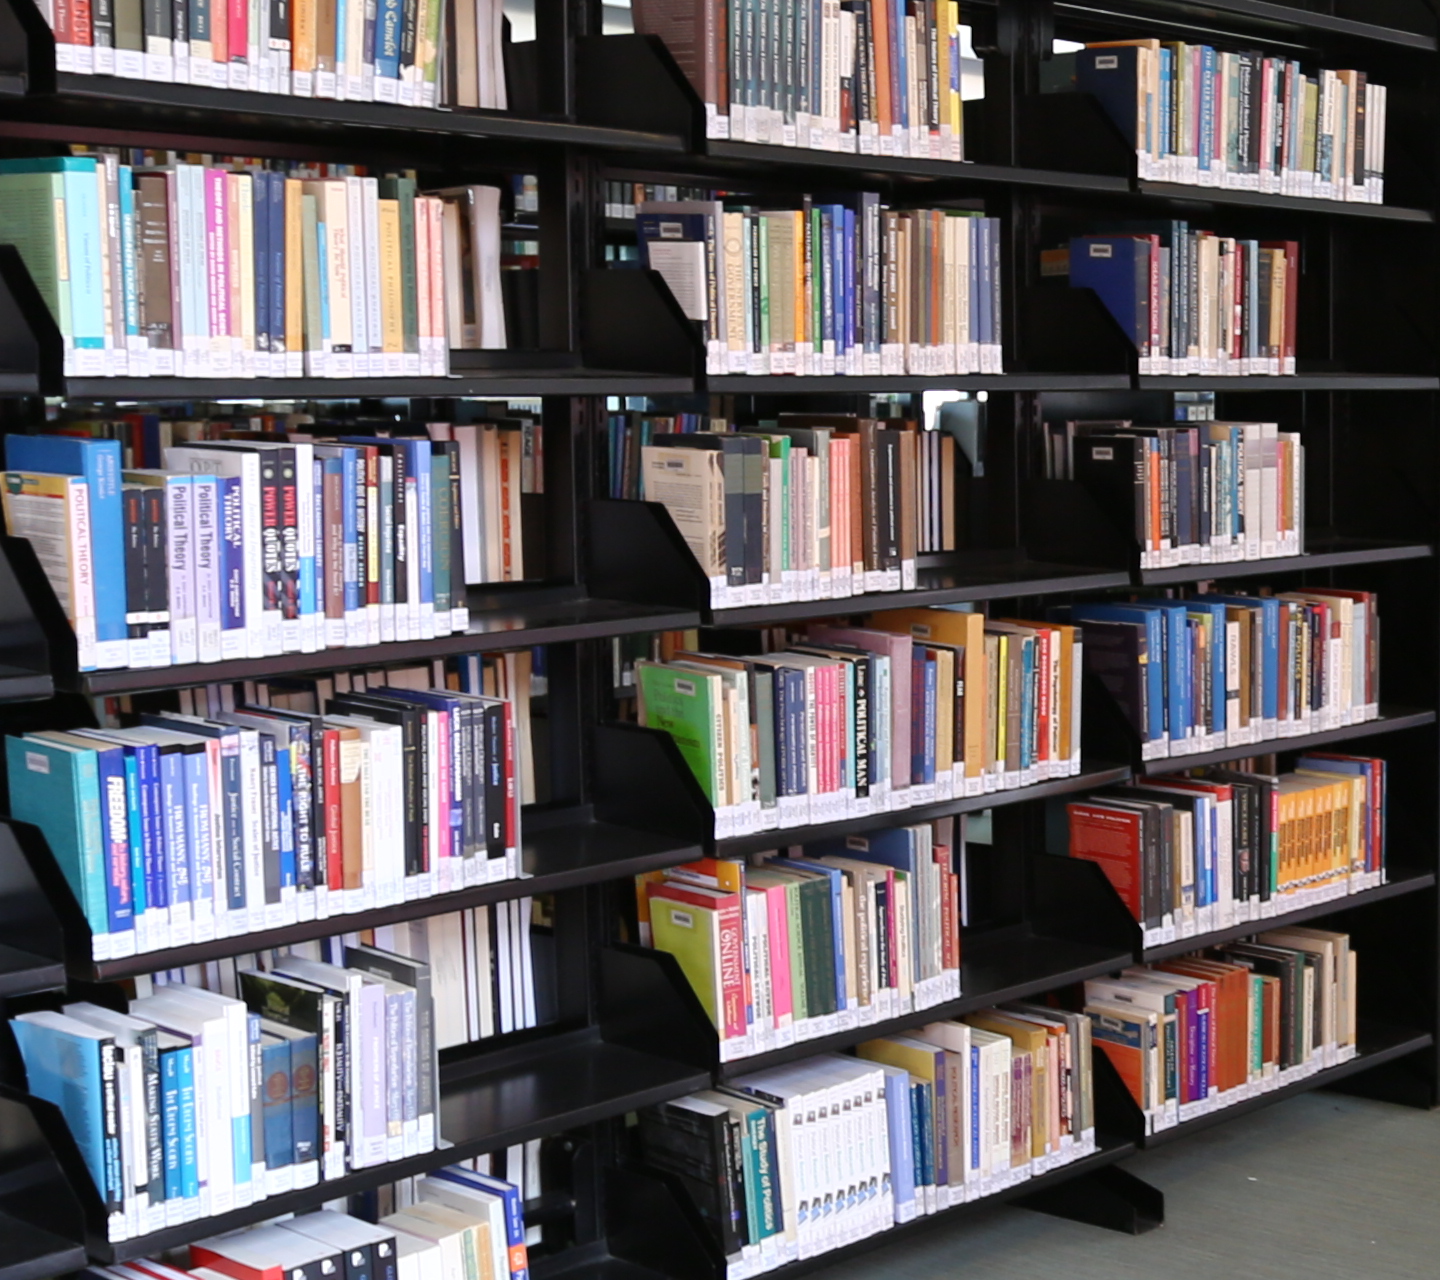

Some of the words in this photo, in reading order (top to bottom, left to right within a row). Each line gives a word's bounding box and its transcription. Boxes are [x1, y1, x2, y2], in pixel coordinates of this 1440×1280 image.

[198, 485, 211, 529] Political
[224, 494, 233, 540] THEORY
[231, 485, 241, 548] POLITICAL
[264, 486, 277, 526] POWER
[199, 531, 213, 569] Theory
[855, 699, 867, 756] POLITICAL
[857, 758, 867, 787] MAN
[756, 1117, 766, 1136] The
[757, 1138, 769, 1172] Study
[762, 1191, 775, 1231] Politics
